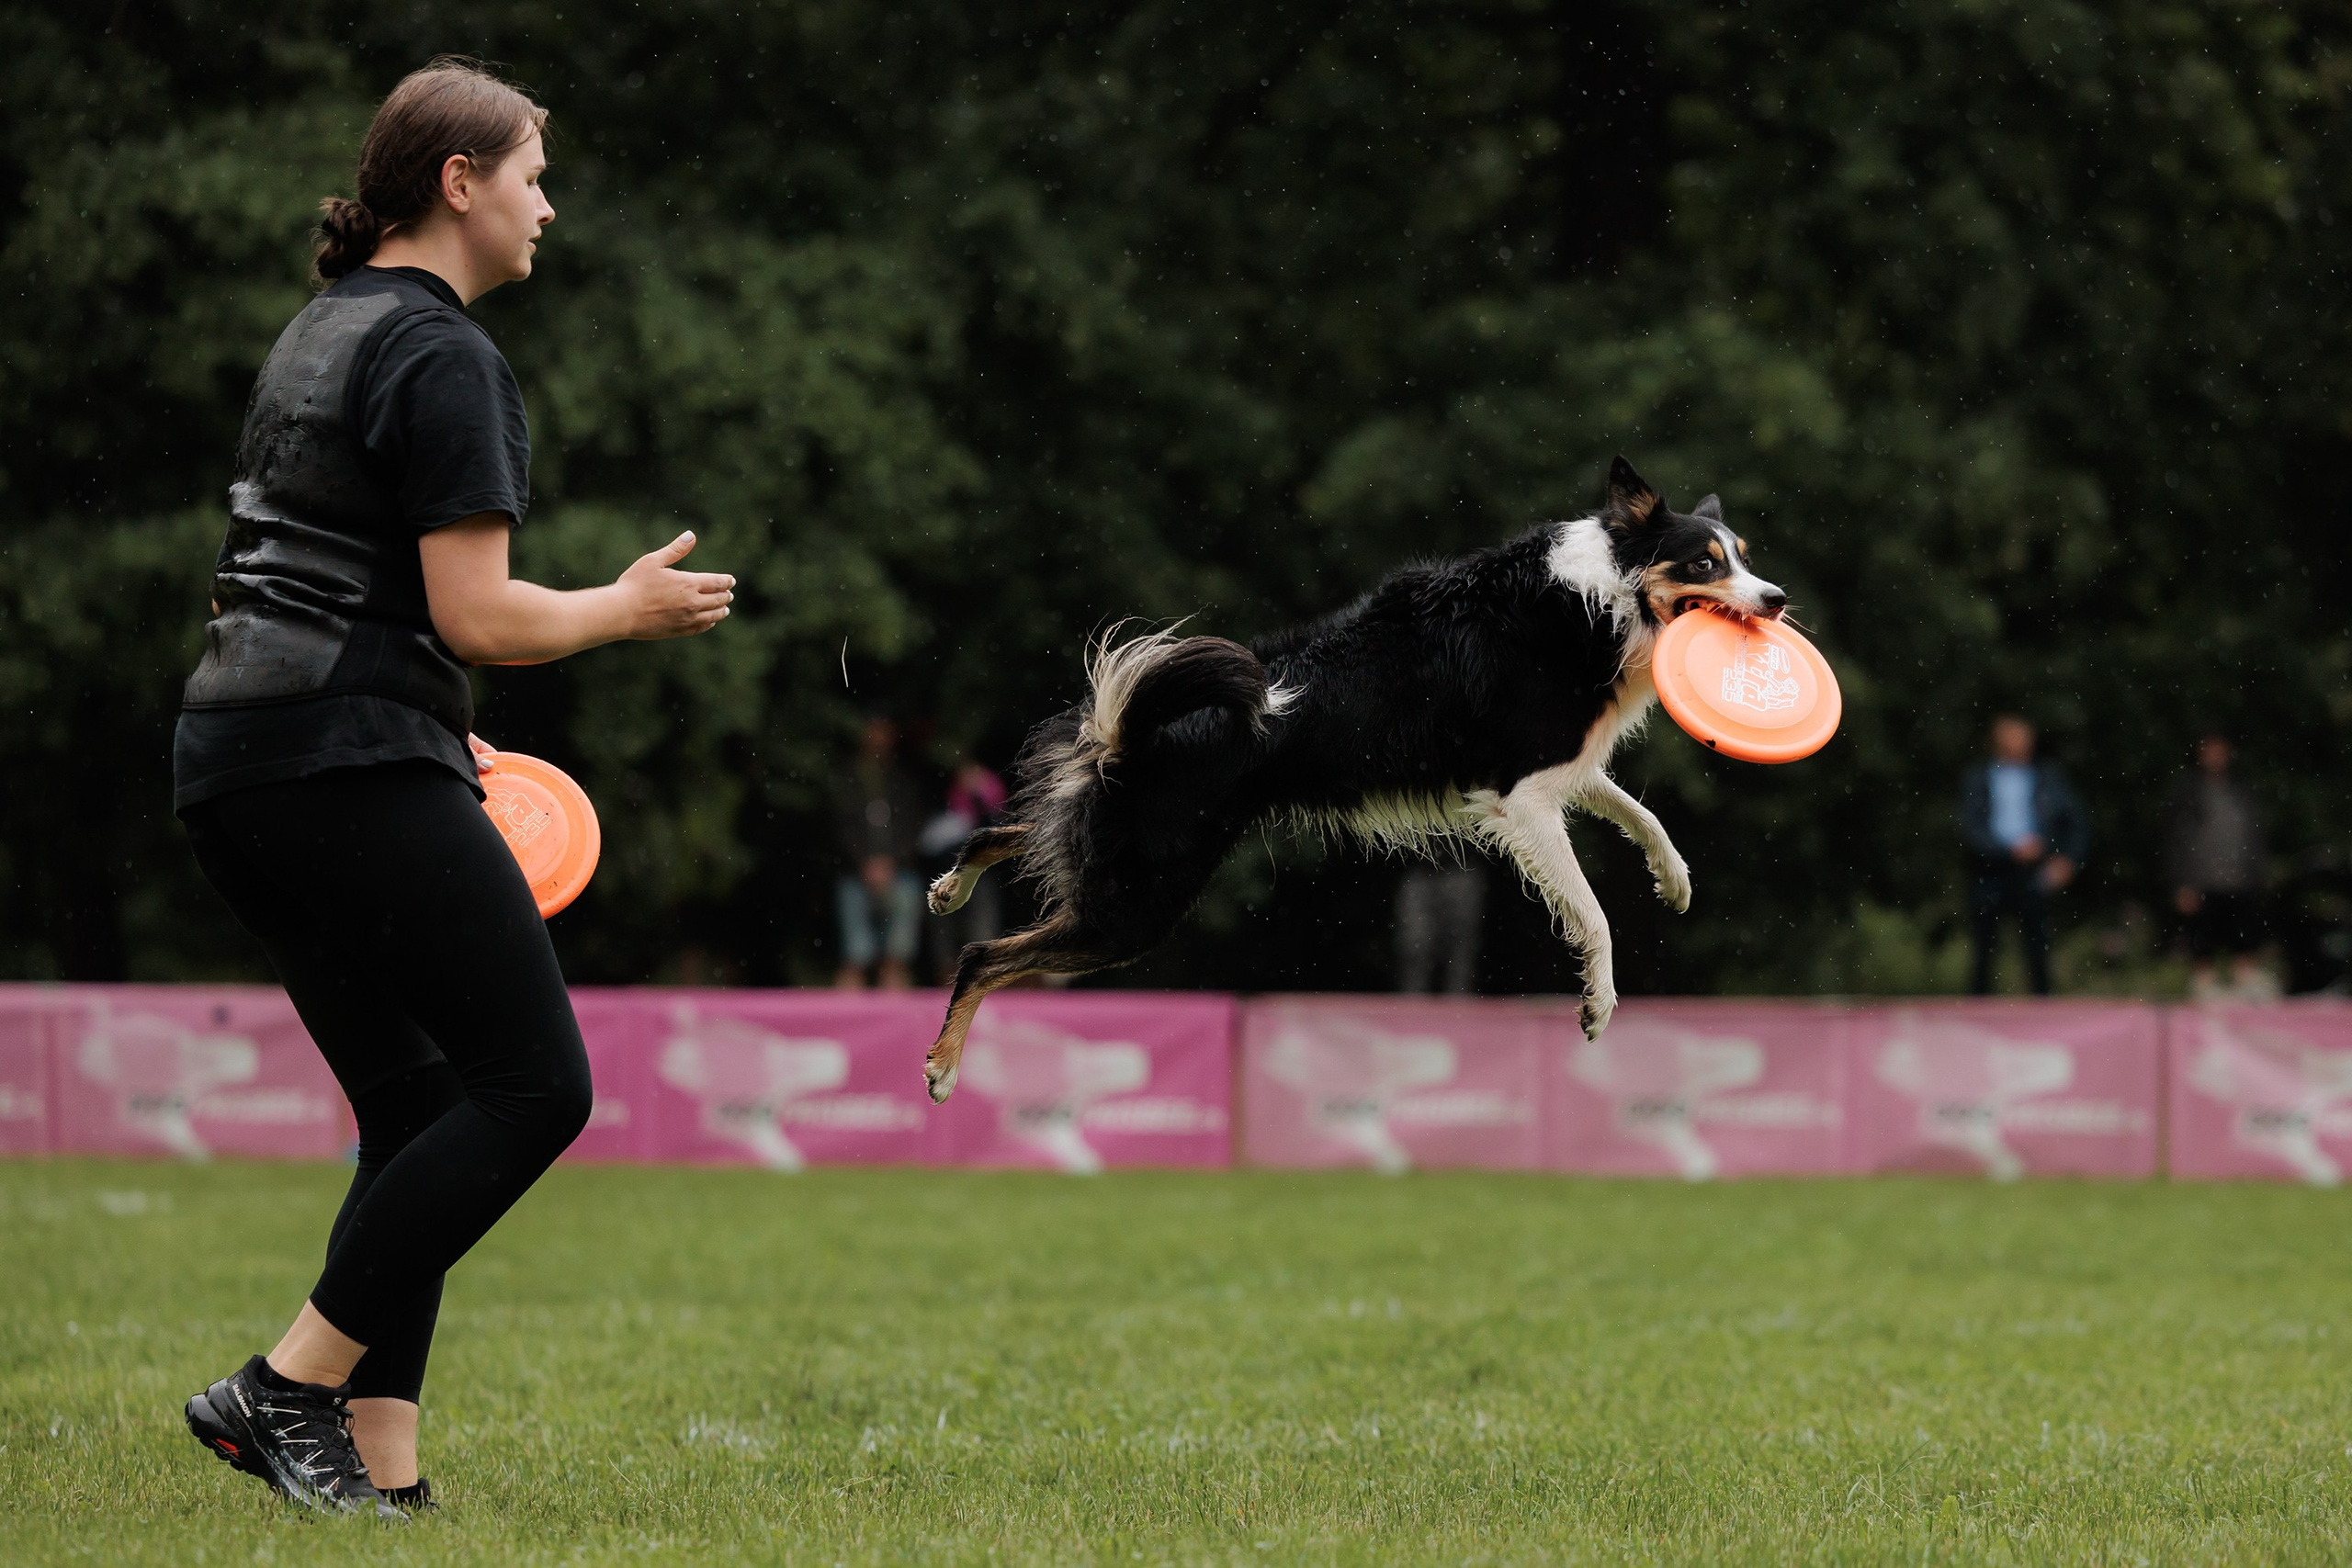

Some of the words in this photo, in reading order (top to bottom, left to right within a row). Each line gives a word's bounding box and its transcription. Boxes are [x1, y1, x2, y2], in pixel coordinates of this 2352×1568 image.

[1724, 667, 1737, 703] 235
[515, 815, 551, 846] 235
[232, 1383, 252, 1417] SALOMON
